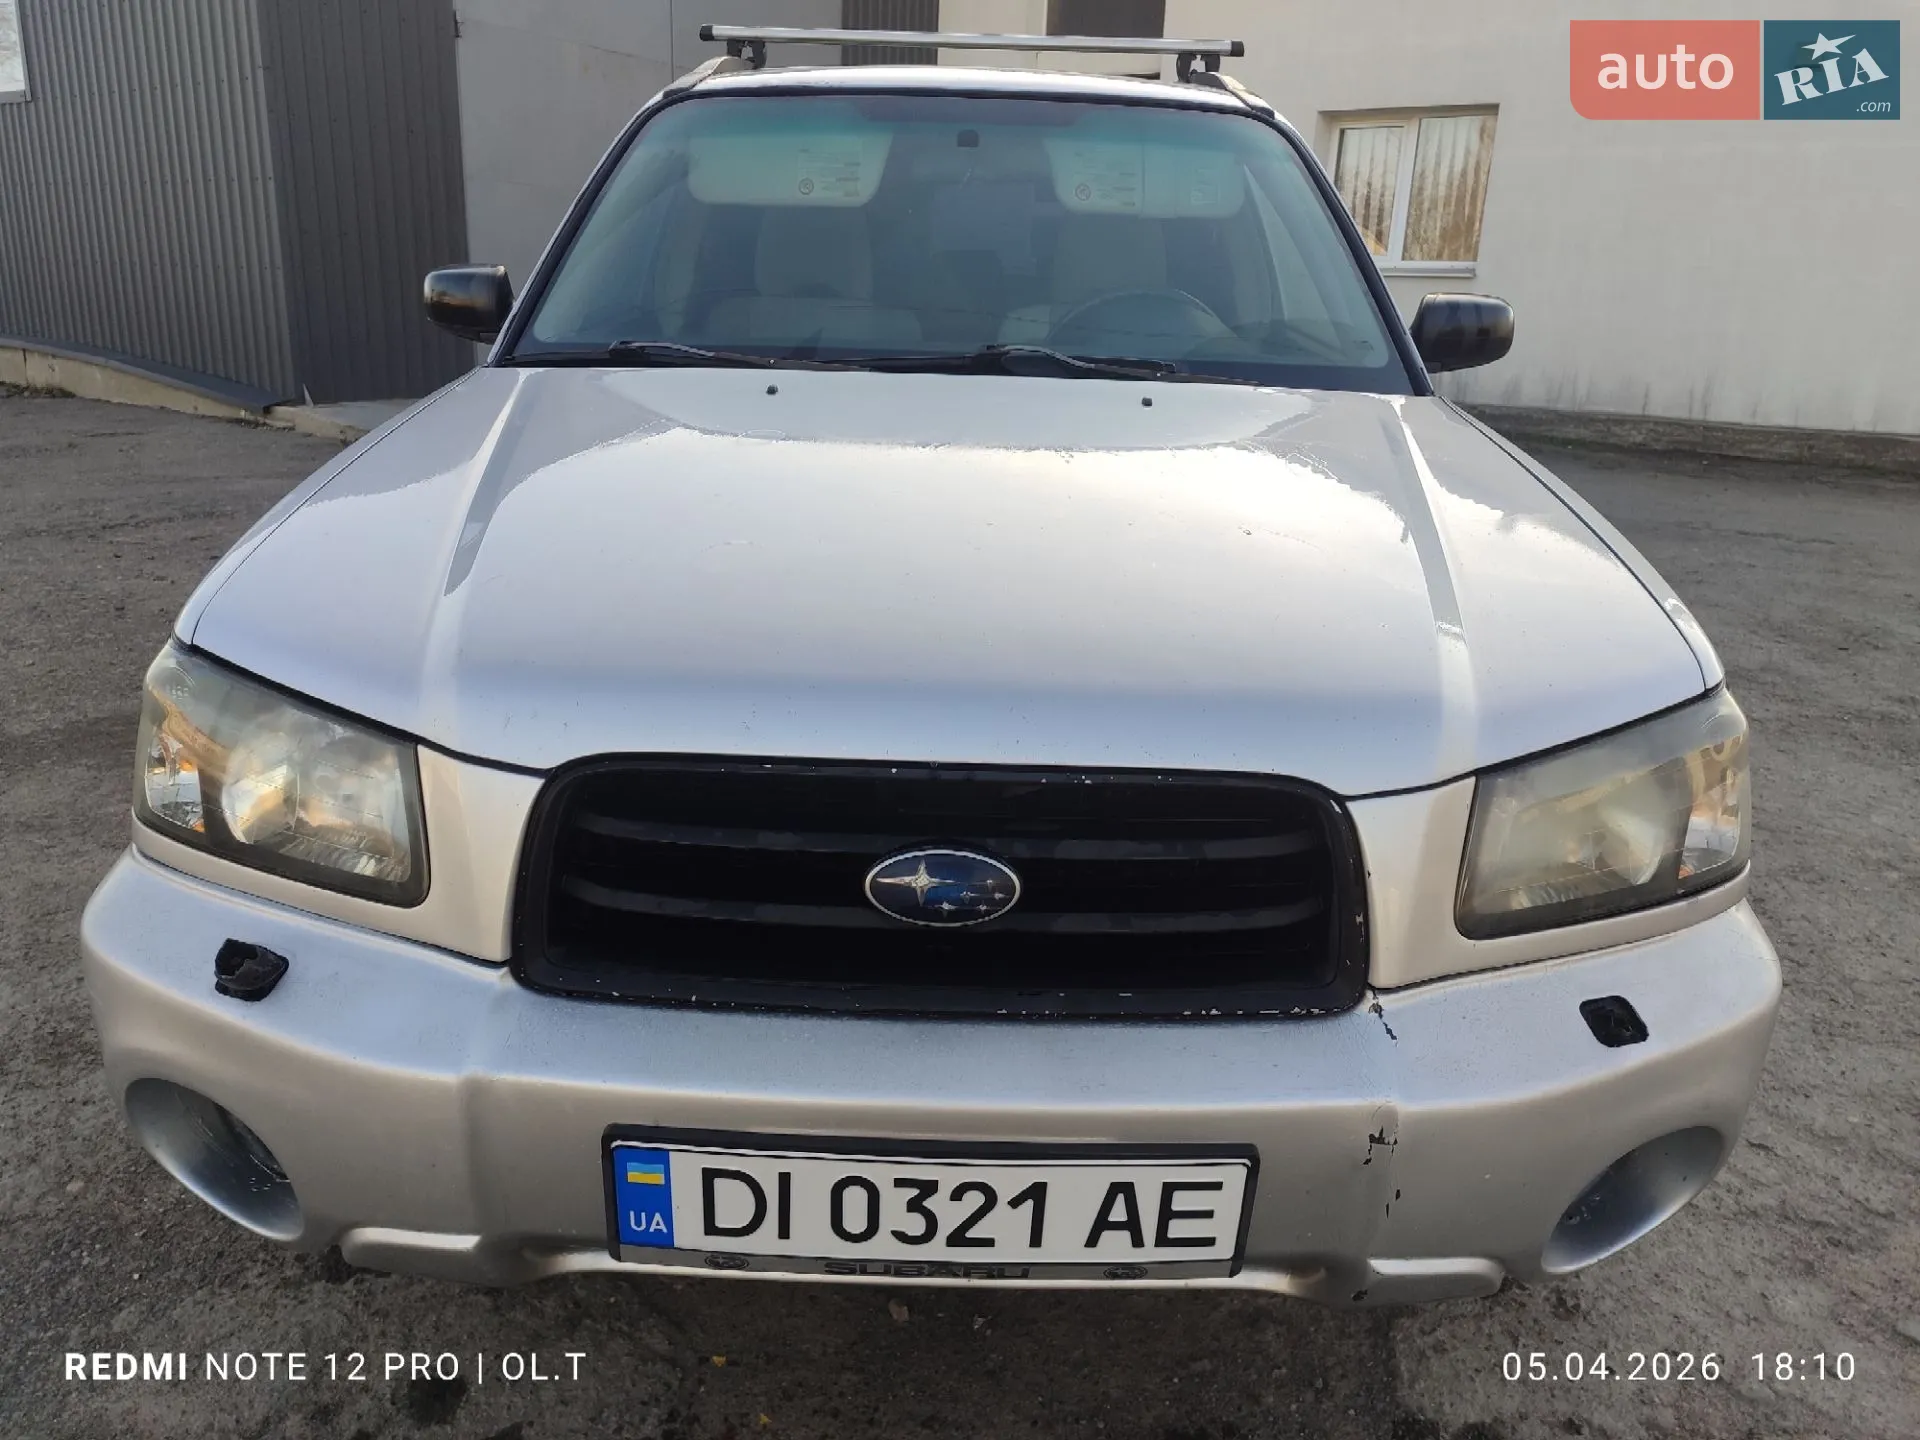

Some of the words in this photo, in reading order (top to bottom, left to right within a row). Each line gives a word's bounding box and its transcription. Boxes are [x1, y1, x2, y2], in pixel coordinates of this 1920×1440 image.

[701, 1167, 791, 1240] DI
[830, 1175, 1048, 1249] 0321
[1084, 1181, 1223, 1249] AE
[630, 1210, 668, 1235] UA
[823, 1261, 1030, 1279] SUBARU
